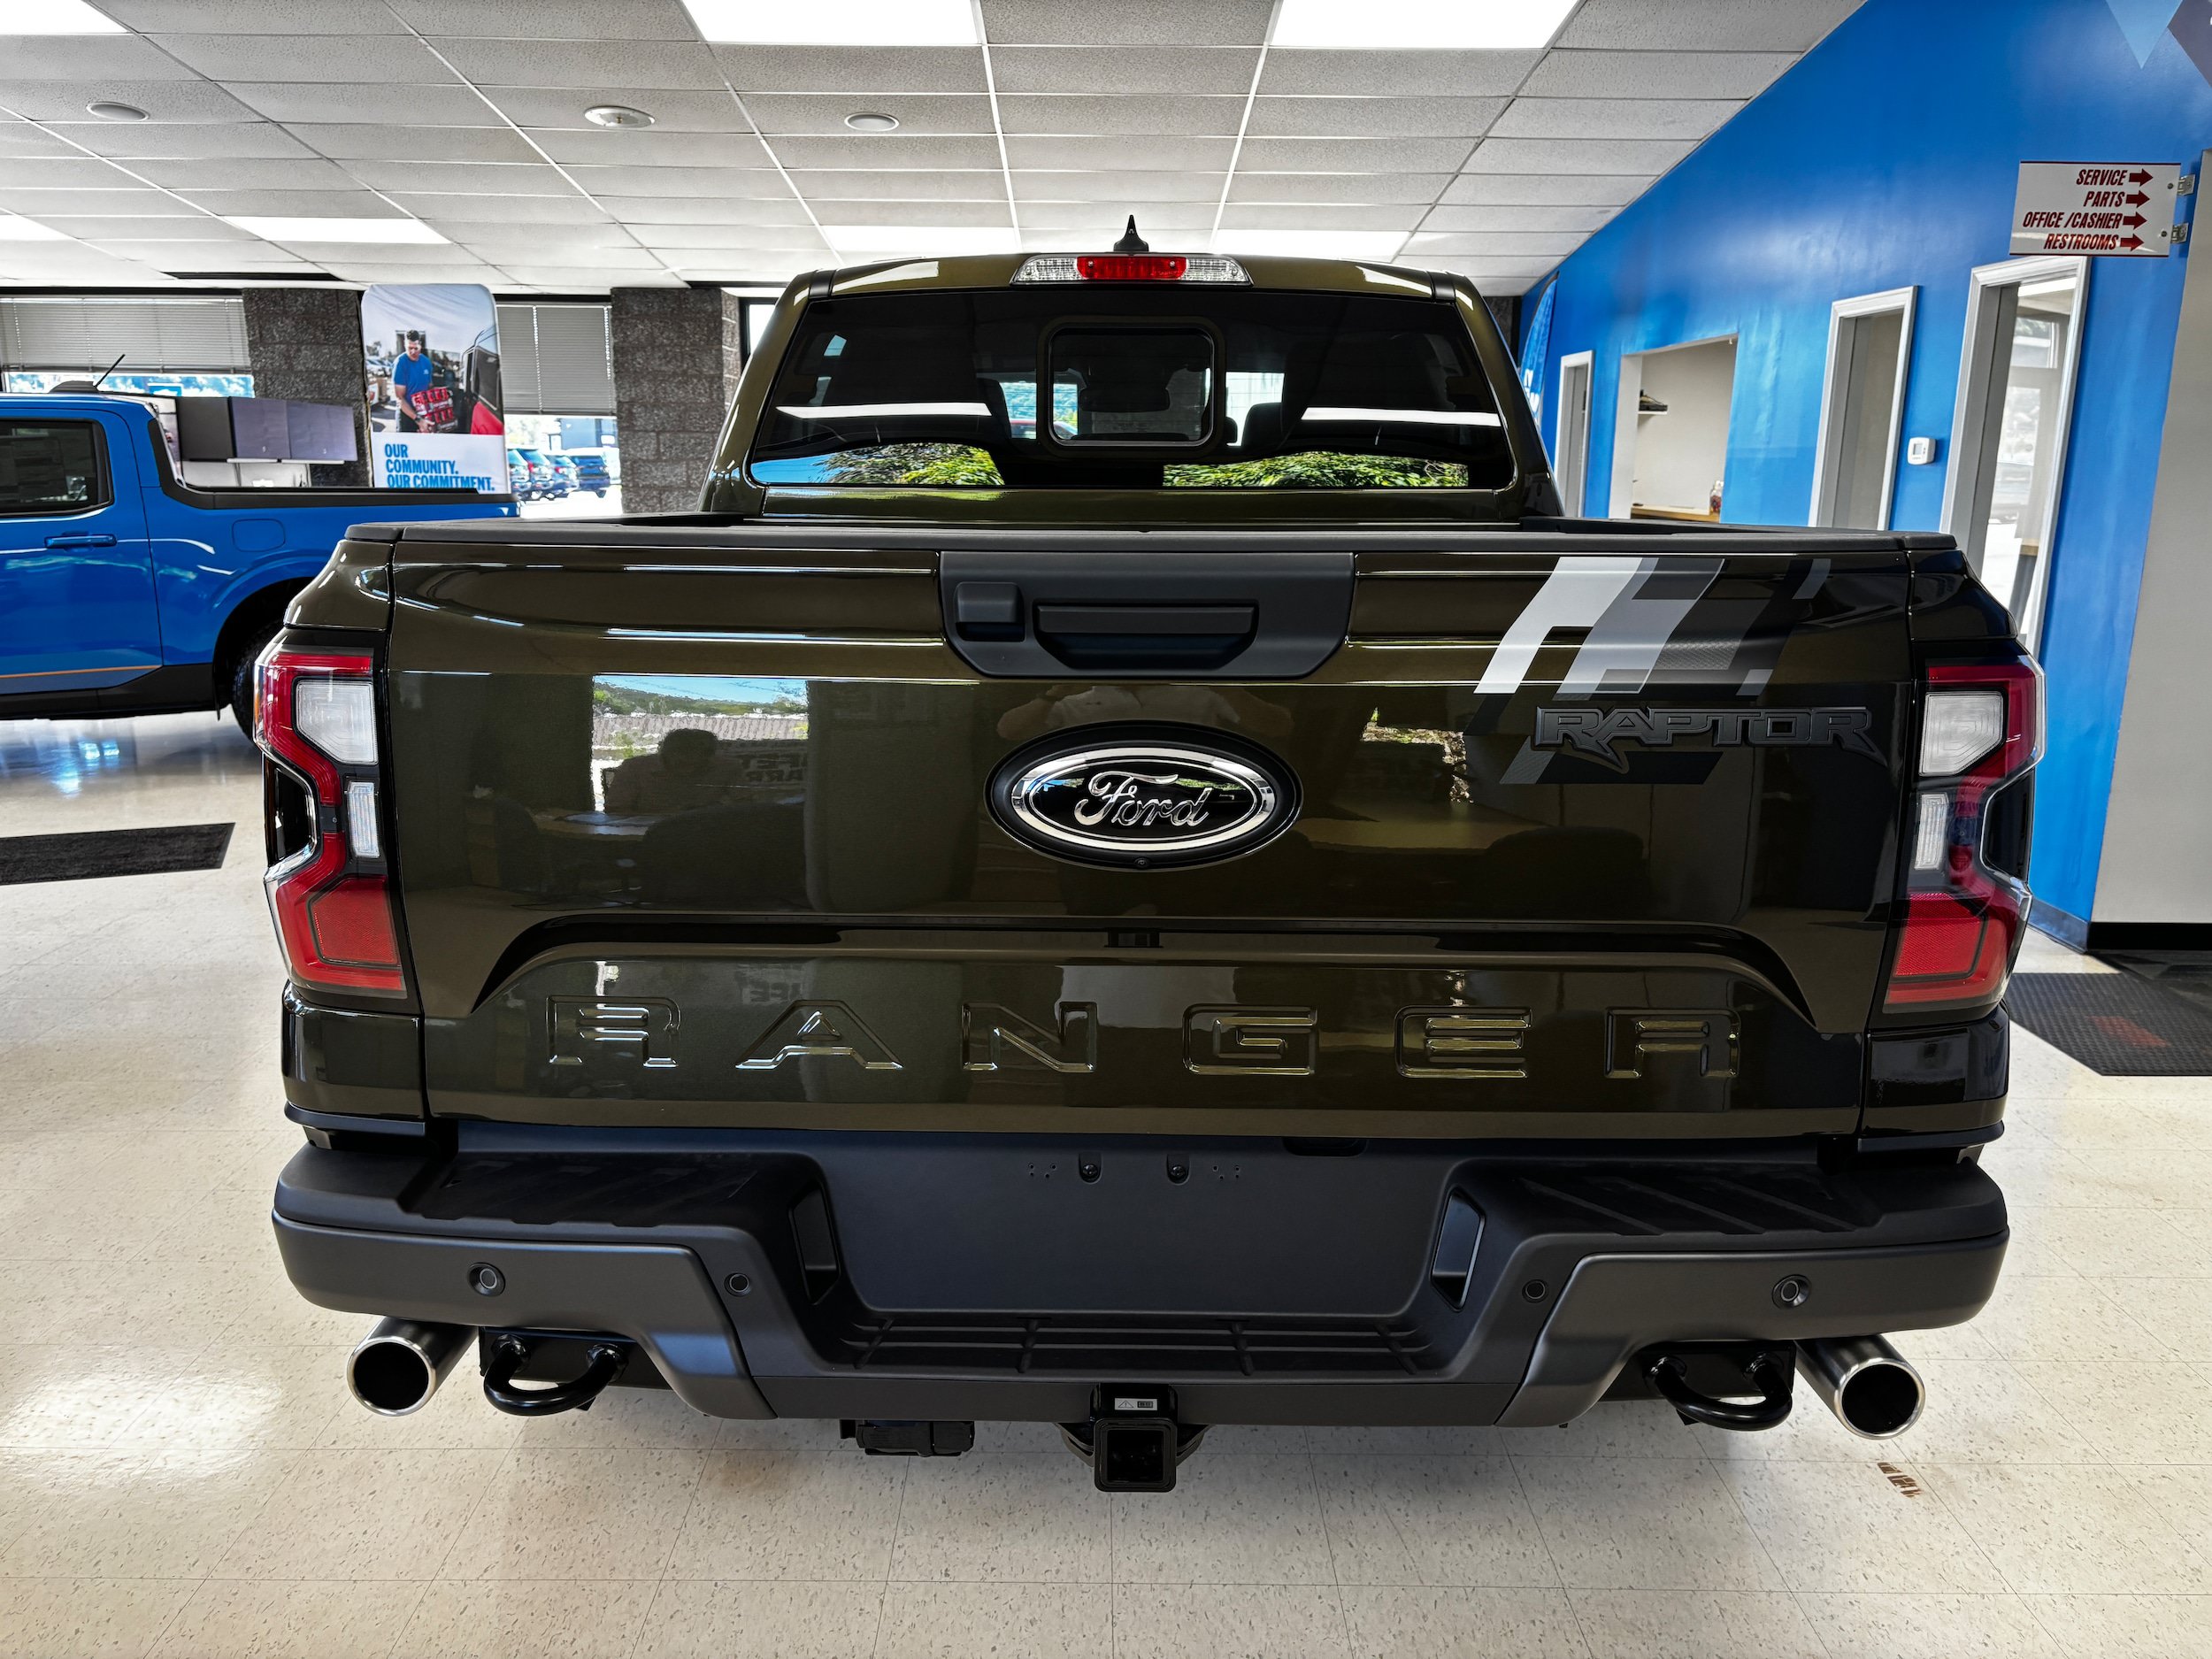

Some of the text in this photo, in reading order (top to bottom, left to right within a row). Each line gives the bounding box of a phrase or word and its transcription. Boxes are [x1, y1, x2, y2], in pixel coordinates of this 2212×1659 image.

[2076, 169, 2128, 186] SERVICE
[2083, 191, 2125, 207] PARTS
[2023, 211, 2064, 227] OFFICE
[2043, 234, 2119, 250] RESTROOMS
[385, 443, 408, 457] OUR
[386, 459, 458, 474] COMMUNITY.
[387, 474, 495, 491] OUR COMMITMENT.
[1535, 706, 1888, 771] RAPTOR
[1074, 771, 1213, 827] Ford
[546, 995, 1741, 1079] RANGER
